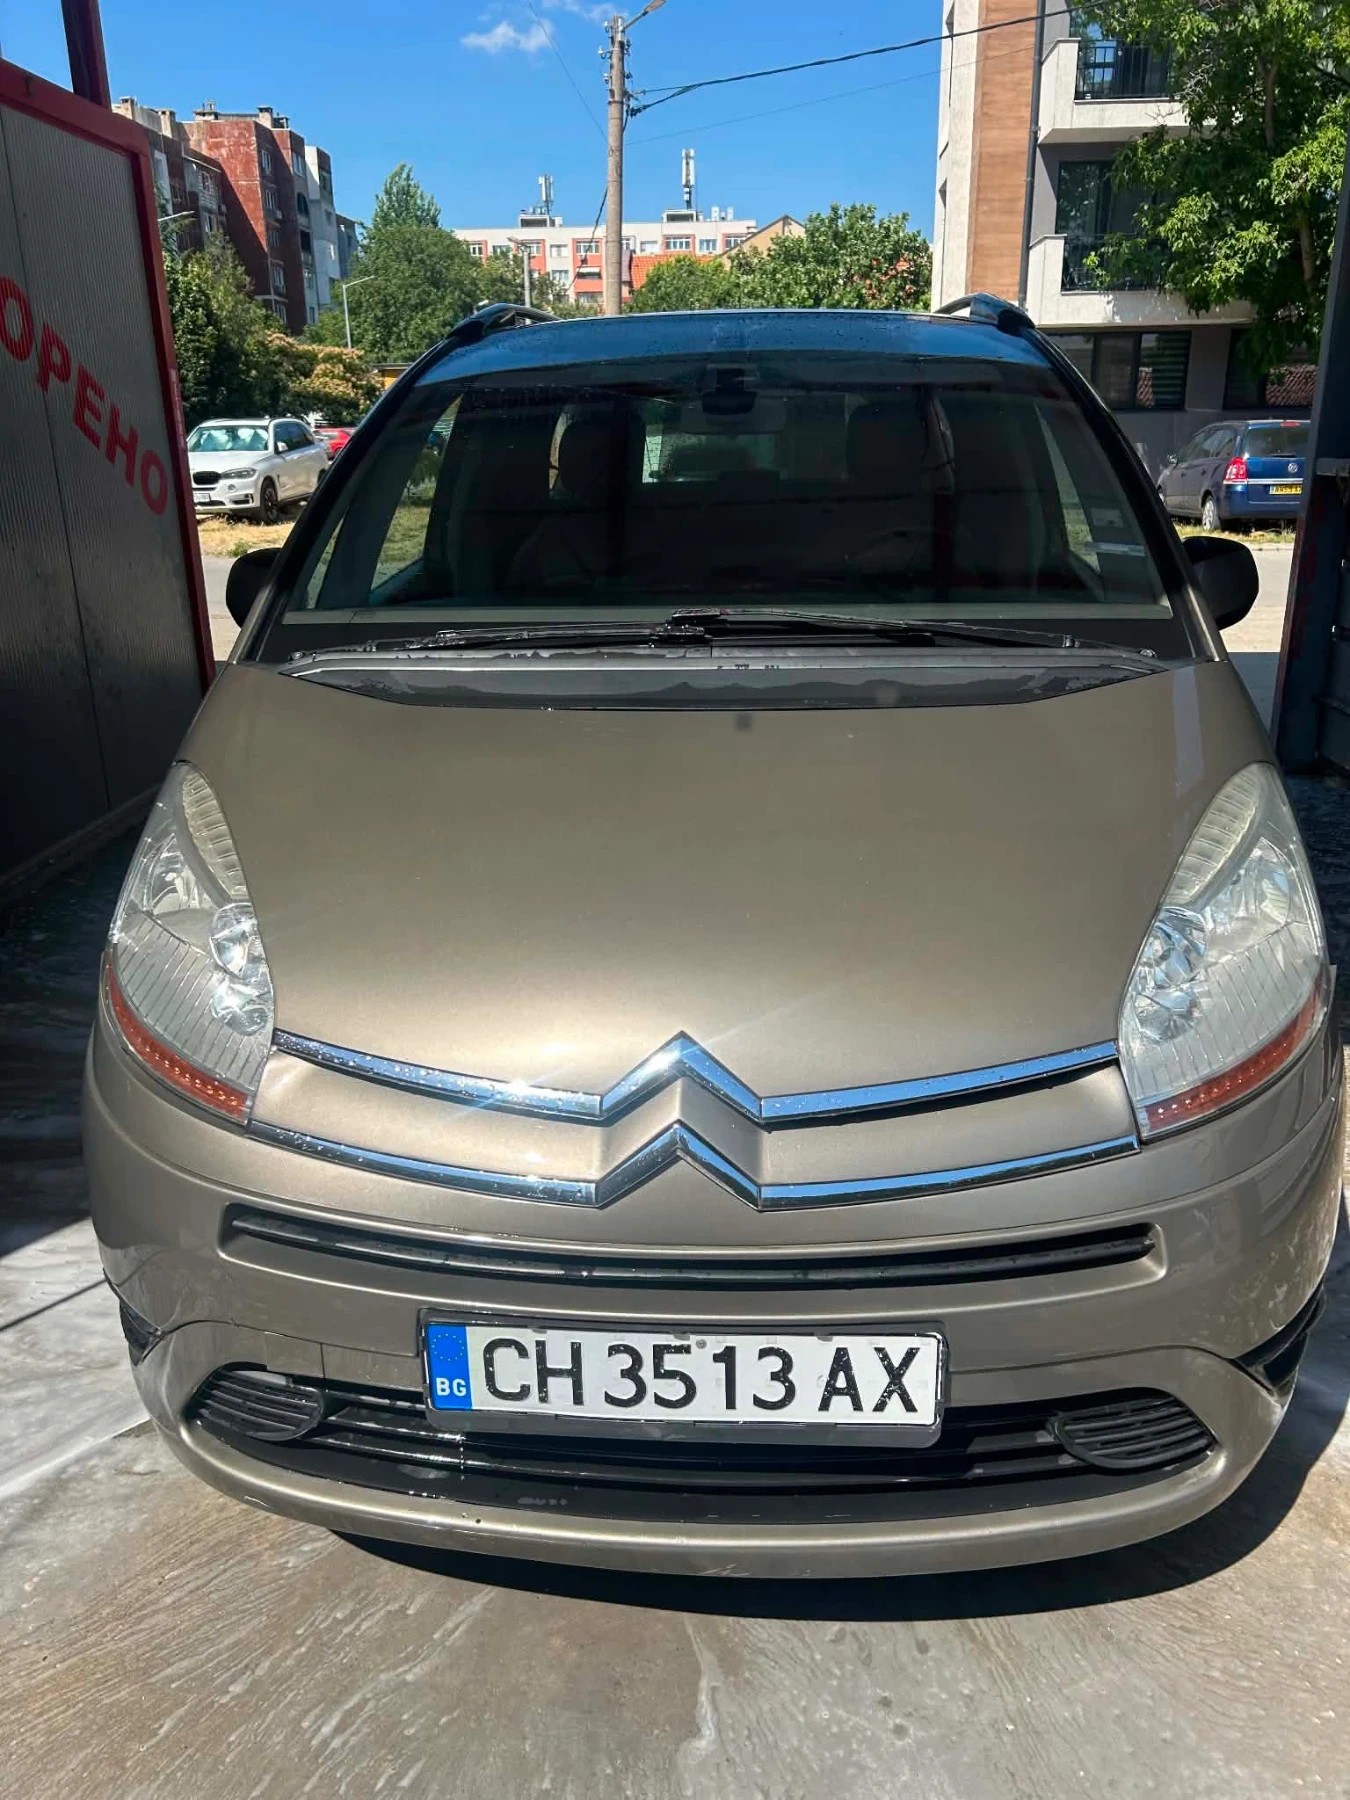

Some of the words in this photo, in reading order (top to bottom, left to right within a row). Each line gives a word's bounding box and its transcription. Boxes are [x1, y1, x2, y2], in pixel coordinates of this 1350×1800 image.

[435, 1377, 467, 1397] BG
[483, 1338, 585, 1406] CH
[603, 1343, 797, 1412] 3513
[817, 1346, 921, 1412] AX
